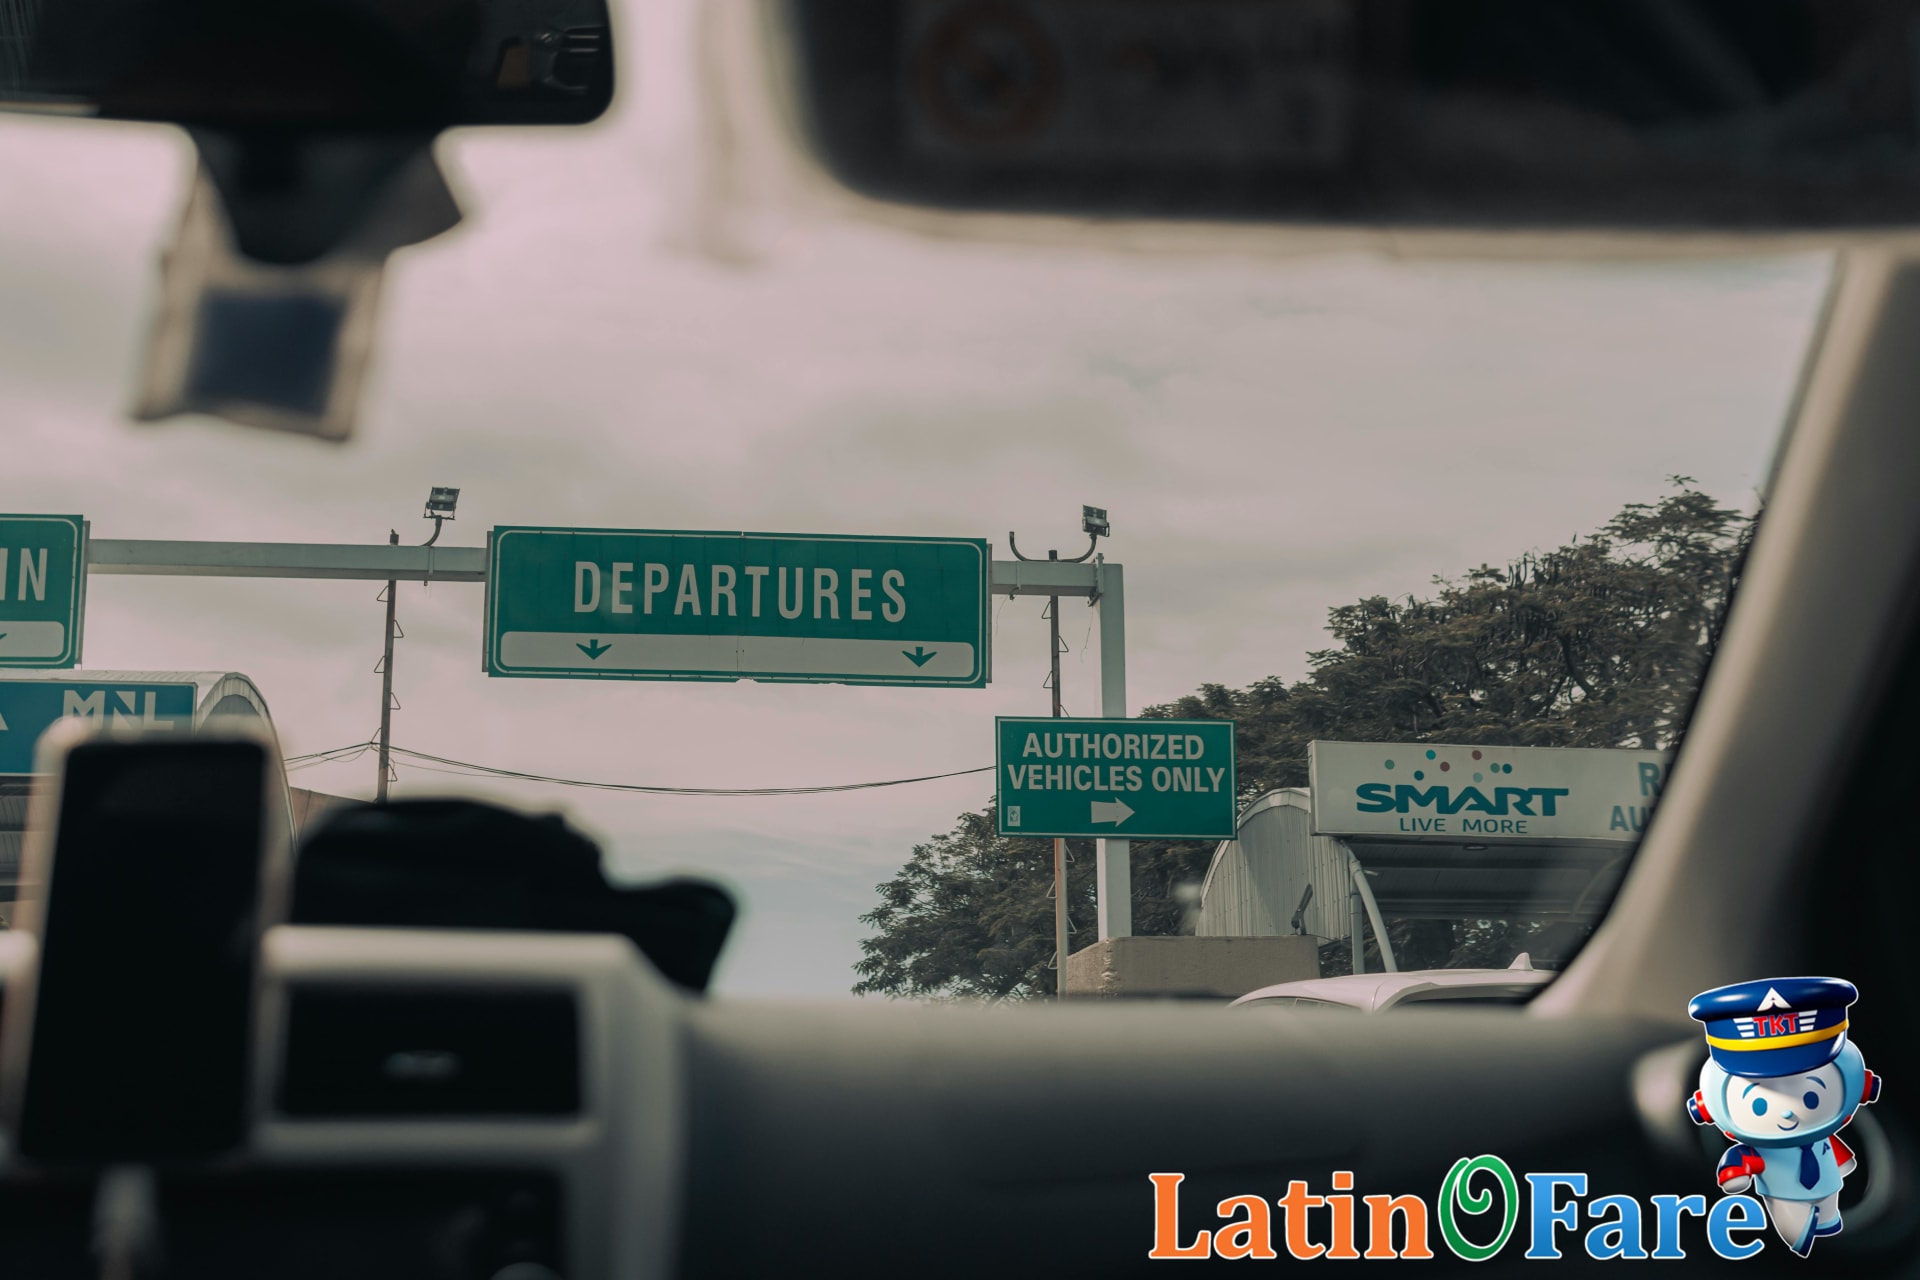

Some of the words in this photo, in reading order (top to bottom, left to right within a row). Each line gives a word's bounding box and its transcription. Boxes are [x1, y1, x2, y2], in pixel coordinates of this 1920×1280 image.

[573, 561, 906, 623] DEPARTURES
[62, 689, 175, 730] MNL
[1022, 732, 1205, 760] AUTHORIZED
[1007, 764, 1143, 791] VEHICLES
[1151, 766, 1226, 793] ONLY
[1356, 783, 1569, 816] SMART
[1400, 817, 1447, 832] LIVE
[1462, 818, 1528, 834] MORE
[1609, 804, 1656, 833] AU
